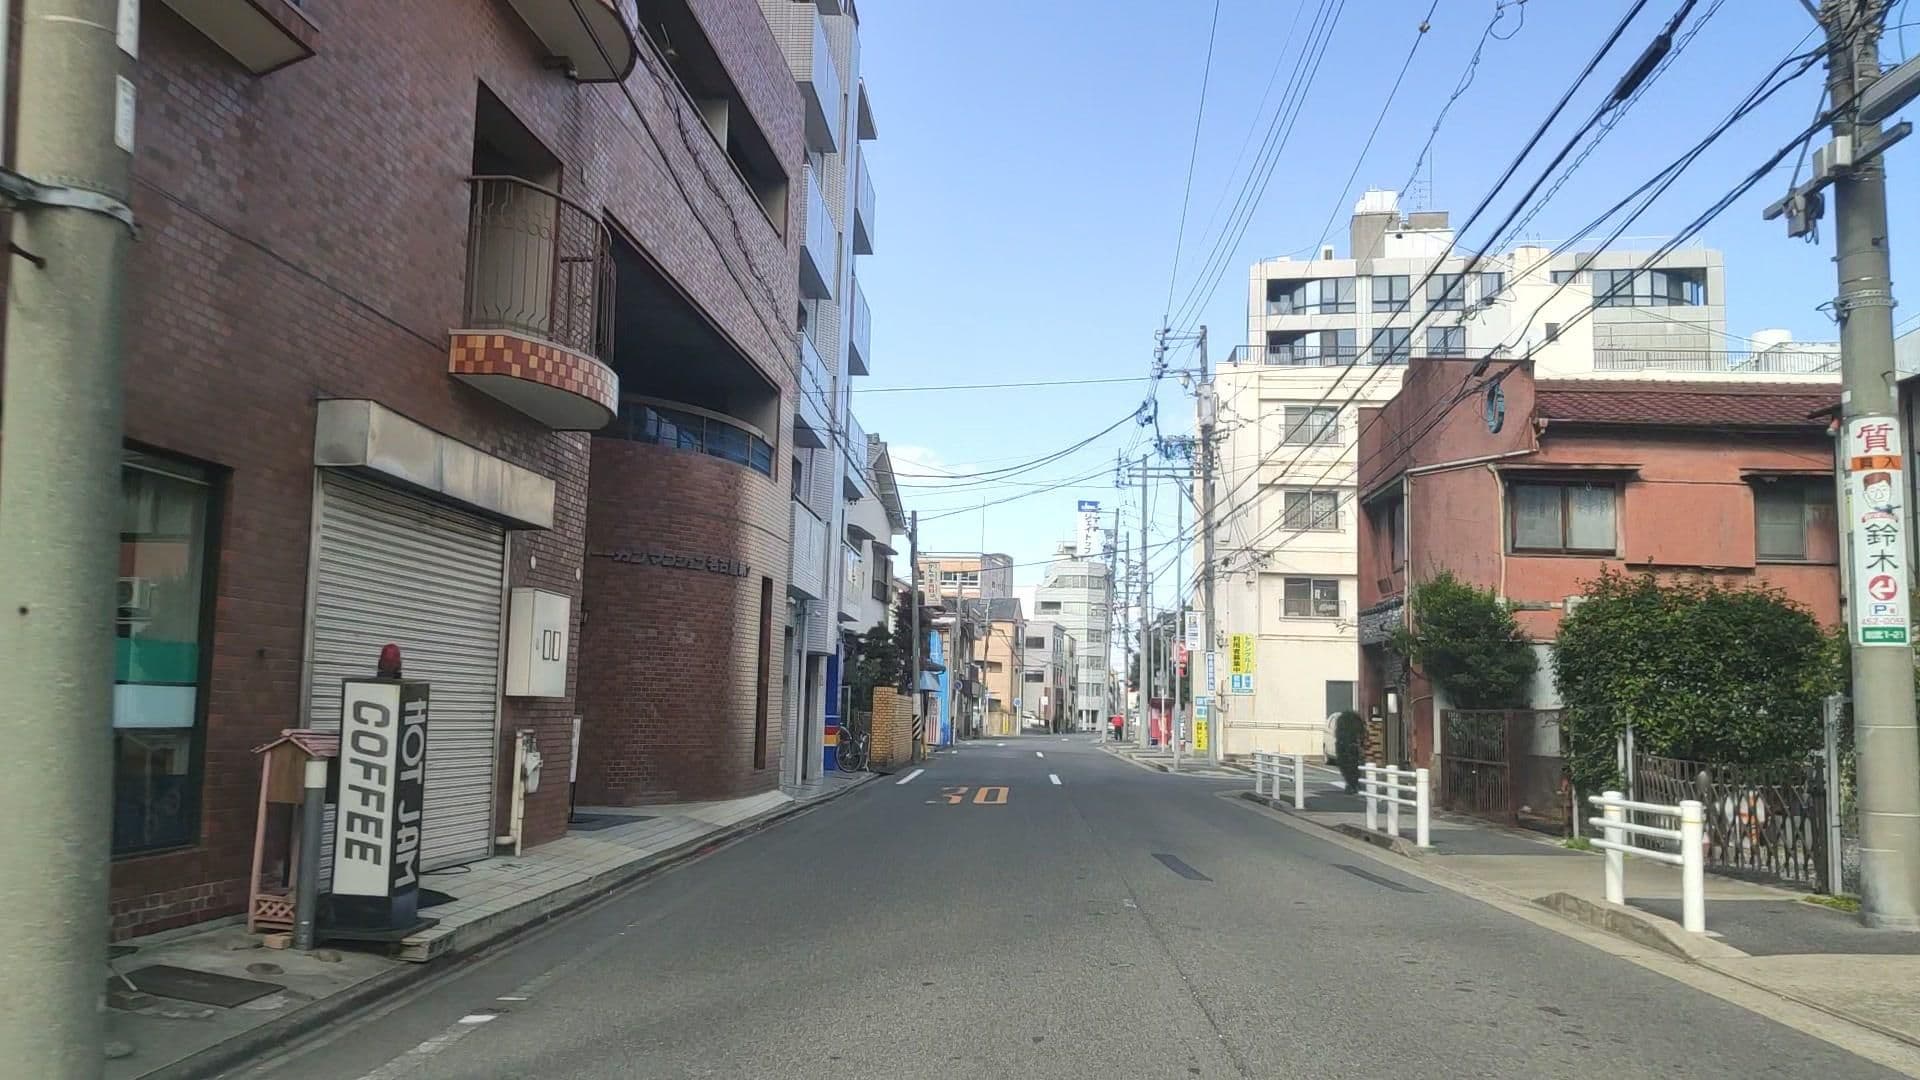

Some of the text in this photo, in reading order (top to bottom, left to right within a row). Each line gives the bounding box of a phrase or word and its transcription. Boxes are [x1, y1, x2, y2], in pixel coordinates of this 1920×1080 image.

[1856, 423, 1894, 453] 質
[1865, 523, 1899, 572] 鈴木
[344, 699, 391, 866] COFFEE
[394, 697, 427, 889] HOT JAM
[942, 786, 1010, 805] 30
